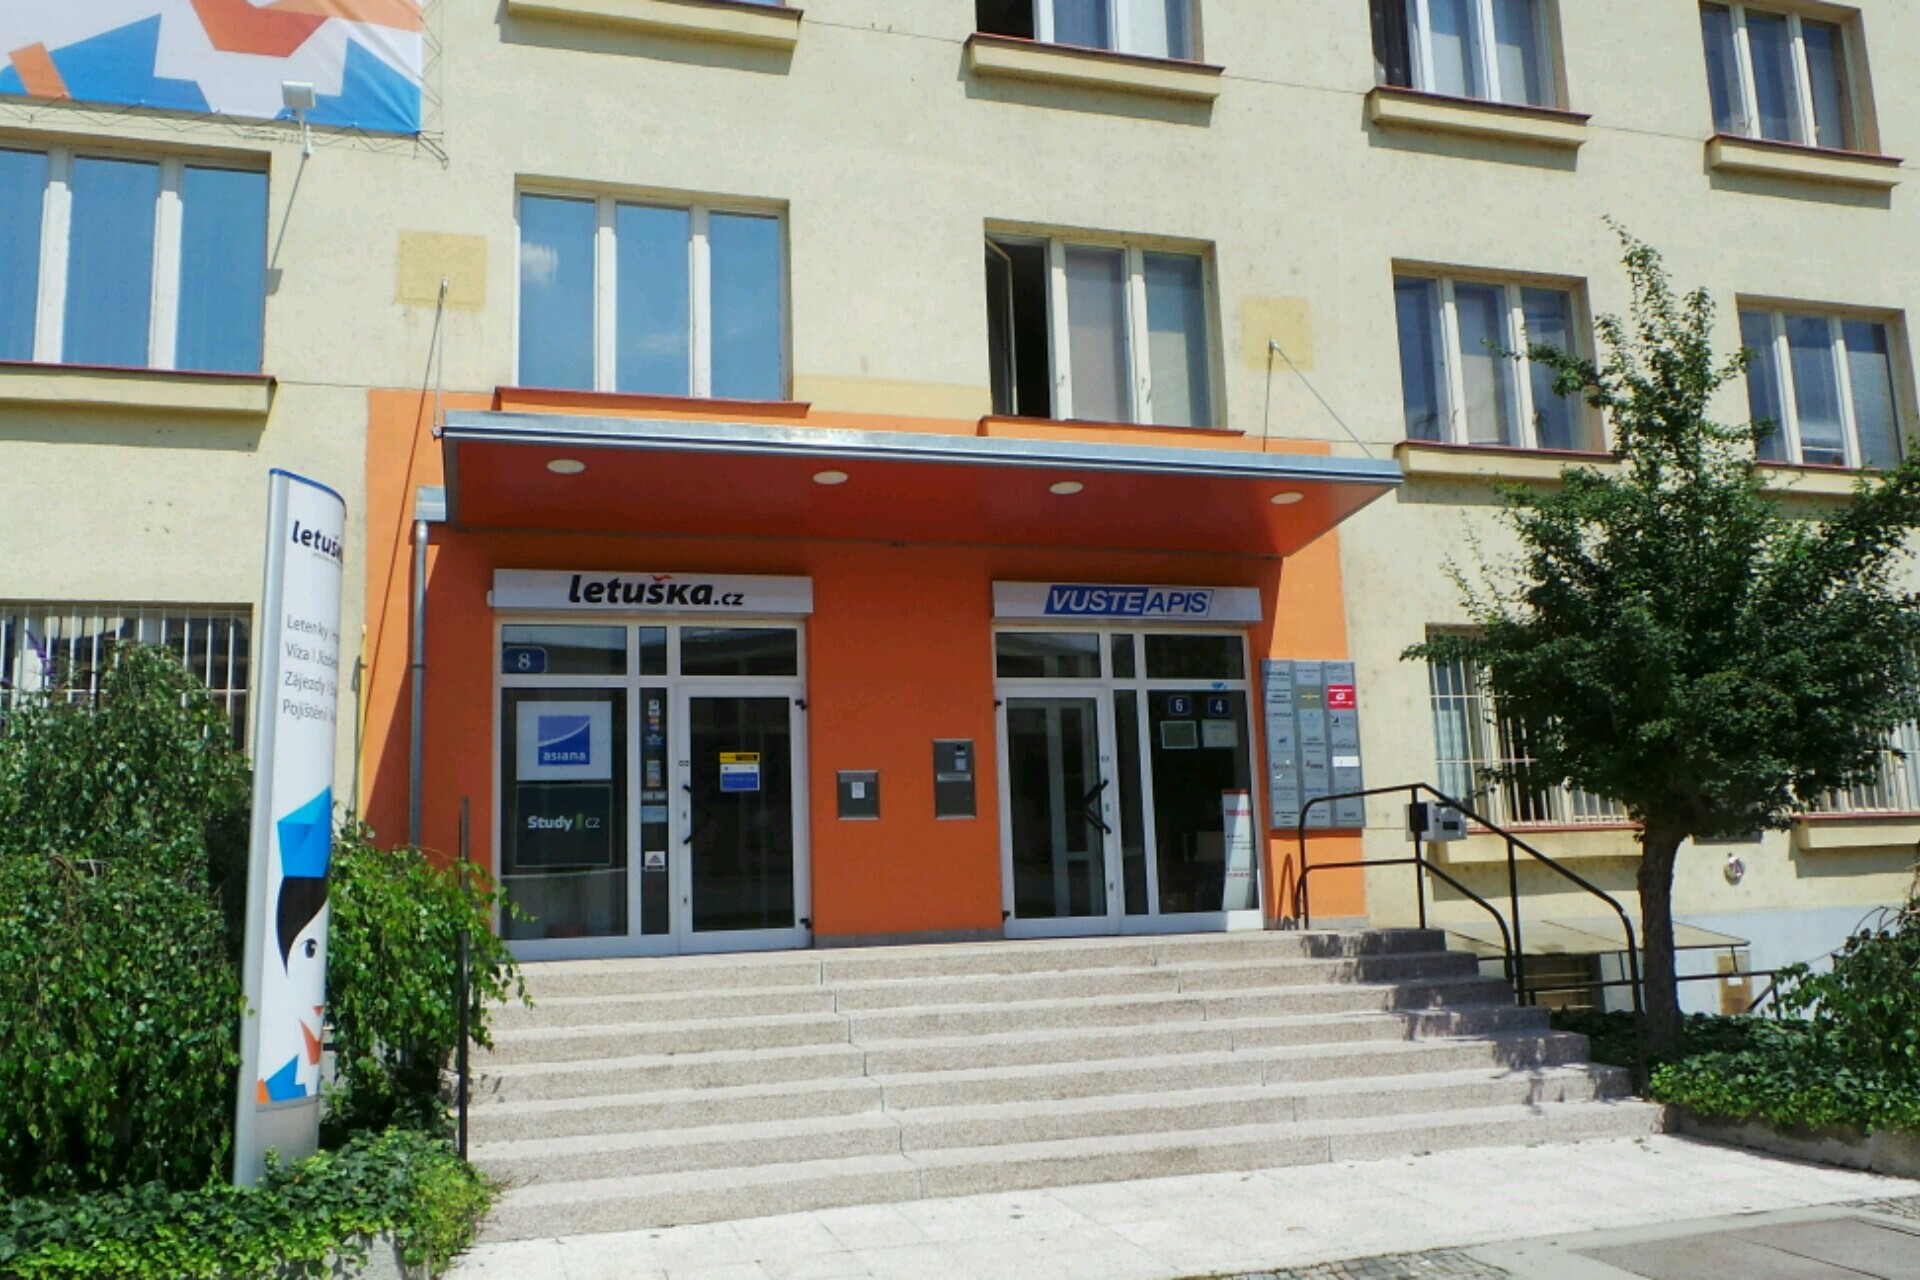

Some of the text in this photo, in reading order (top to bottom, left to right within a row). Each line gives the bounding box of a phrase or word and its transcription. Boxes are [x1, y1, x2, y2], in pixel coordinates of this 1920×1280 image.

[568, 574, 744, 606] letuška.cz
[286, 614, 328, 641] Letenky
[517, 652, 532, 671] 8
[1175, 698, 1224, 713] 6 4
[543, 751, 587, 762] asiana
[527, 814, 574, 832] Study
